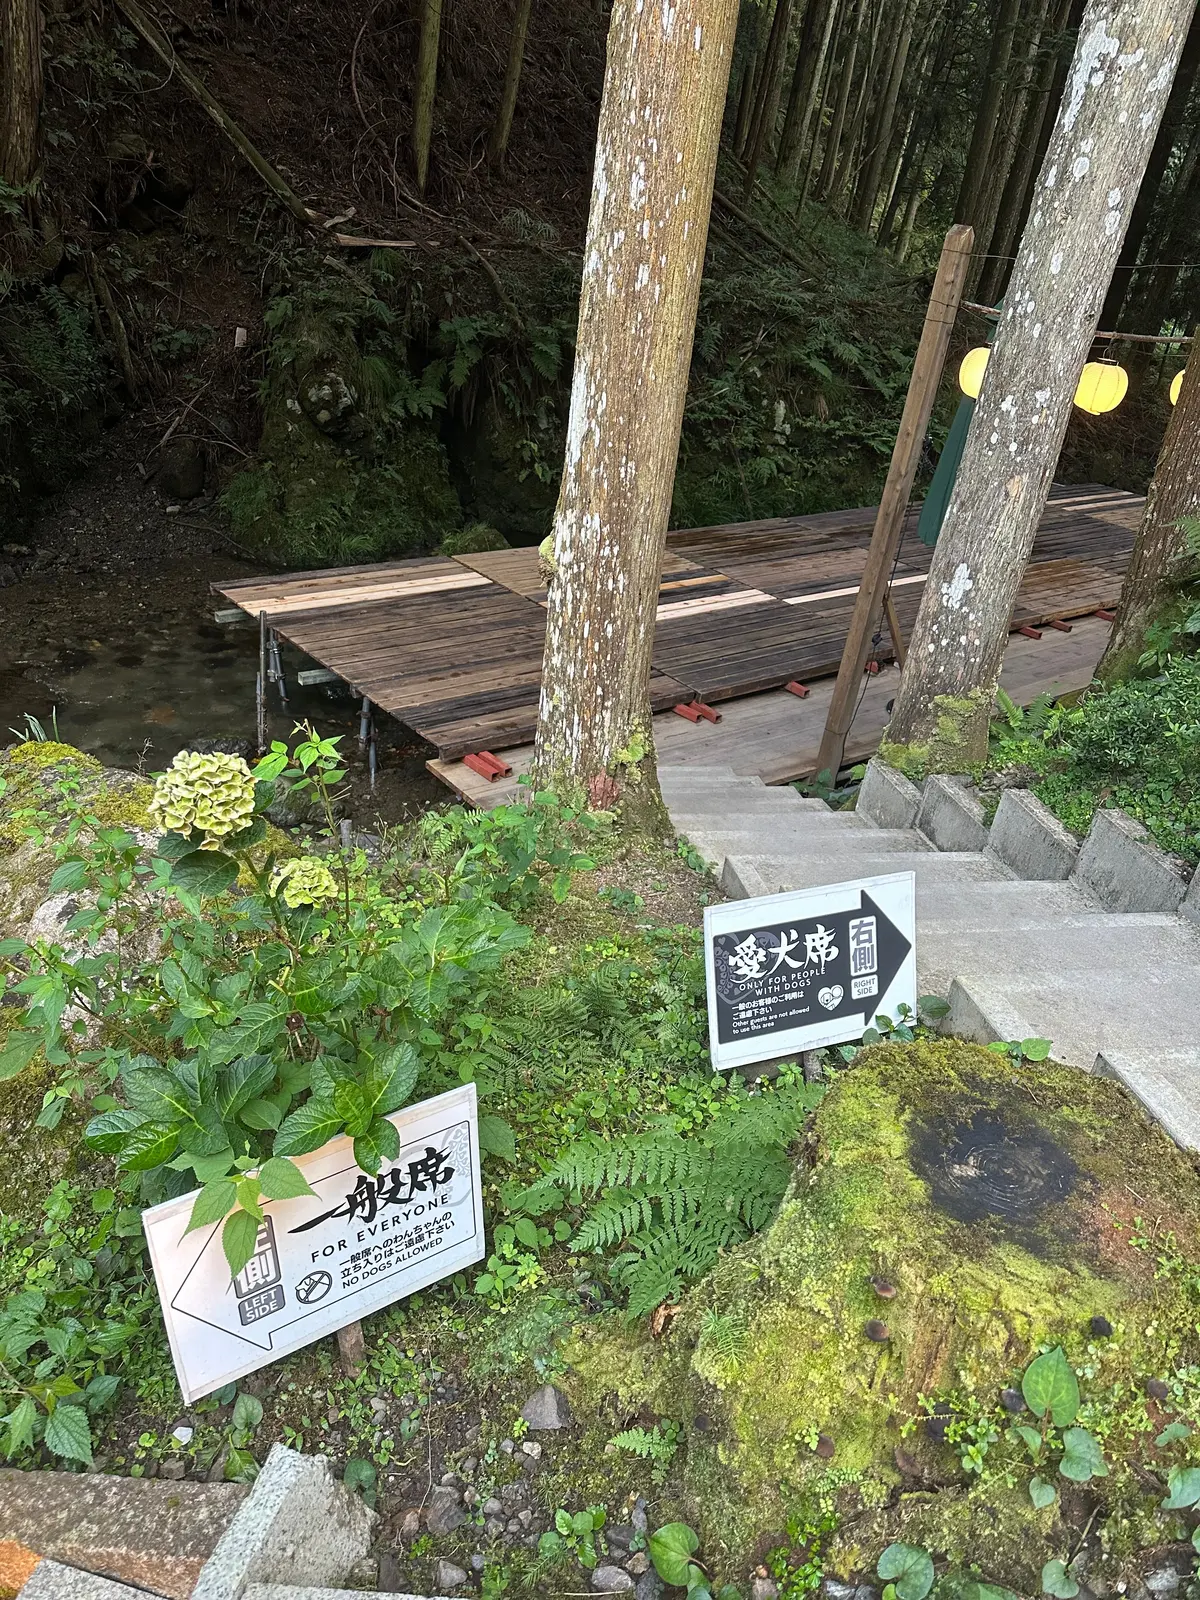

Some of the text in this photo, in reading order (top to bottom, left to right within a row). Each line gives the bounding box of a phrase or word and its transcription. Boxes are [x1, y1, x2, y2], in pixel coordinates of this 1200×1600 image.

[728, 924, 839, 983] 愛犬席
[851, 920, 875, 973] 右側
[739, 968, 826, 991] ONLY FOR PEOPLE
[755, 979, 811, 996] WITH DOGS
[853, 978, 875, 988] RIGHT
[732, 991, 804, 1010] 一般のお客様のご利用は
[857, 987, 873, 996] SIDE
[732, 1020, 749, 1028] Other
[749, 1016, 768, 1025] guests
[789, 1006, 810, 1016] allowed
[287, 1147, 455, 1234] 一般席
[310, 1194, 449, 1263] FOR EVERYONE
[339, 1211, 453, 1266] 一般席へのわんちゃんの
[340, 1220, 455, 1279] 立ち入りはご遠慮下さい
[342, 1237, 443, 1289] NO DOGS ALLOWED
[245, 1289, 277, 1311] LEFT
[246, 1300, 278, 1322] SIDE
